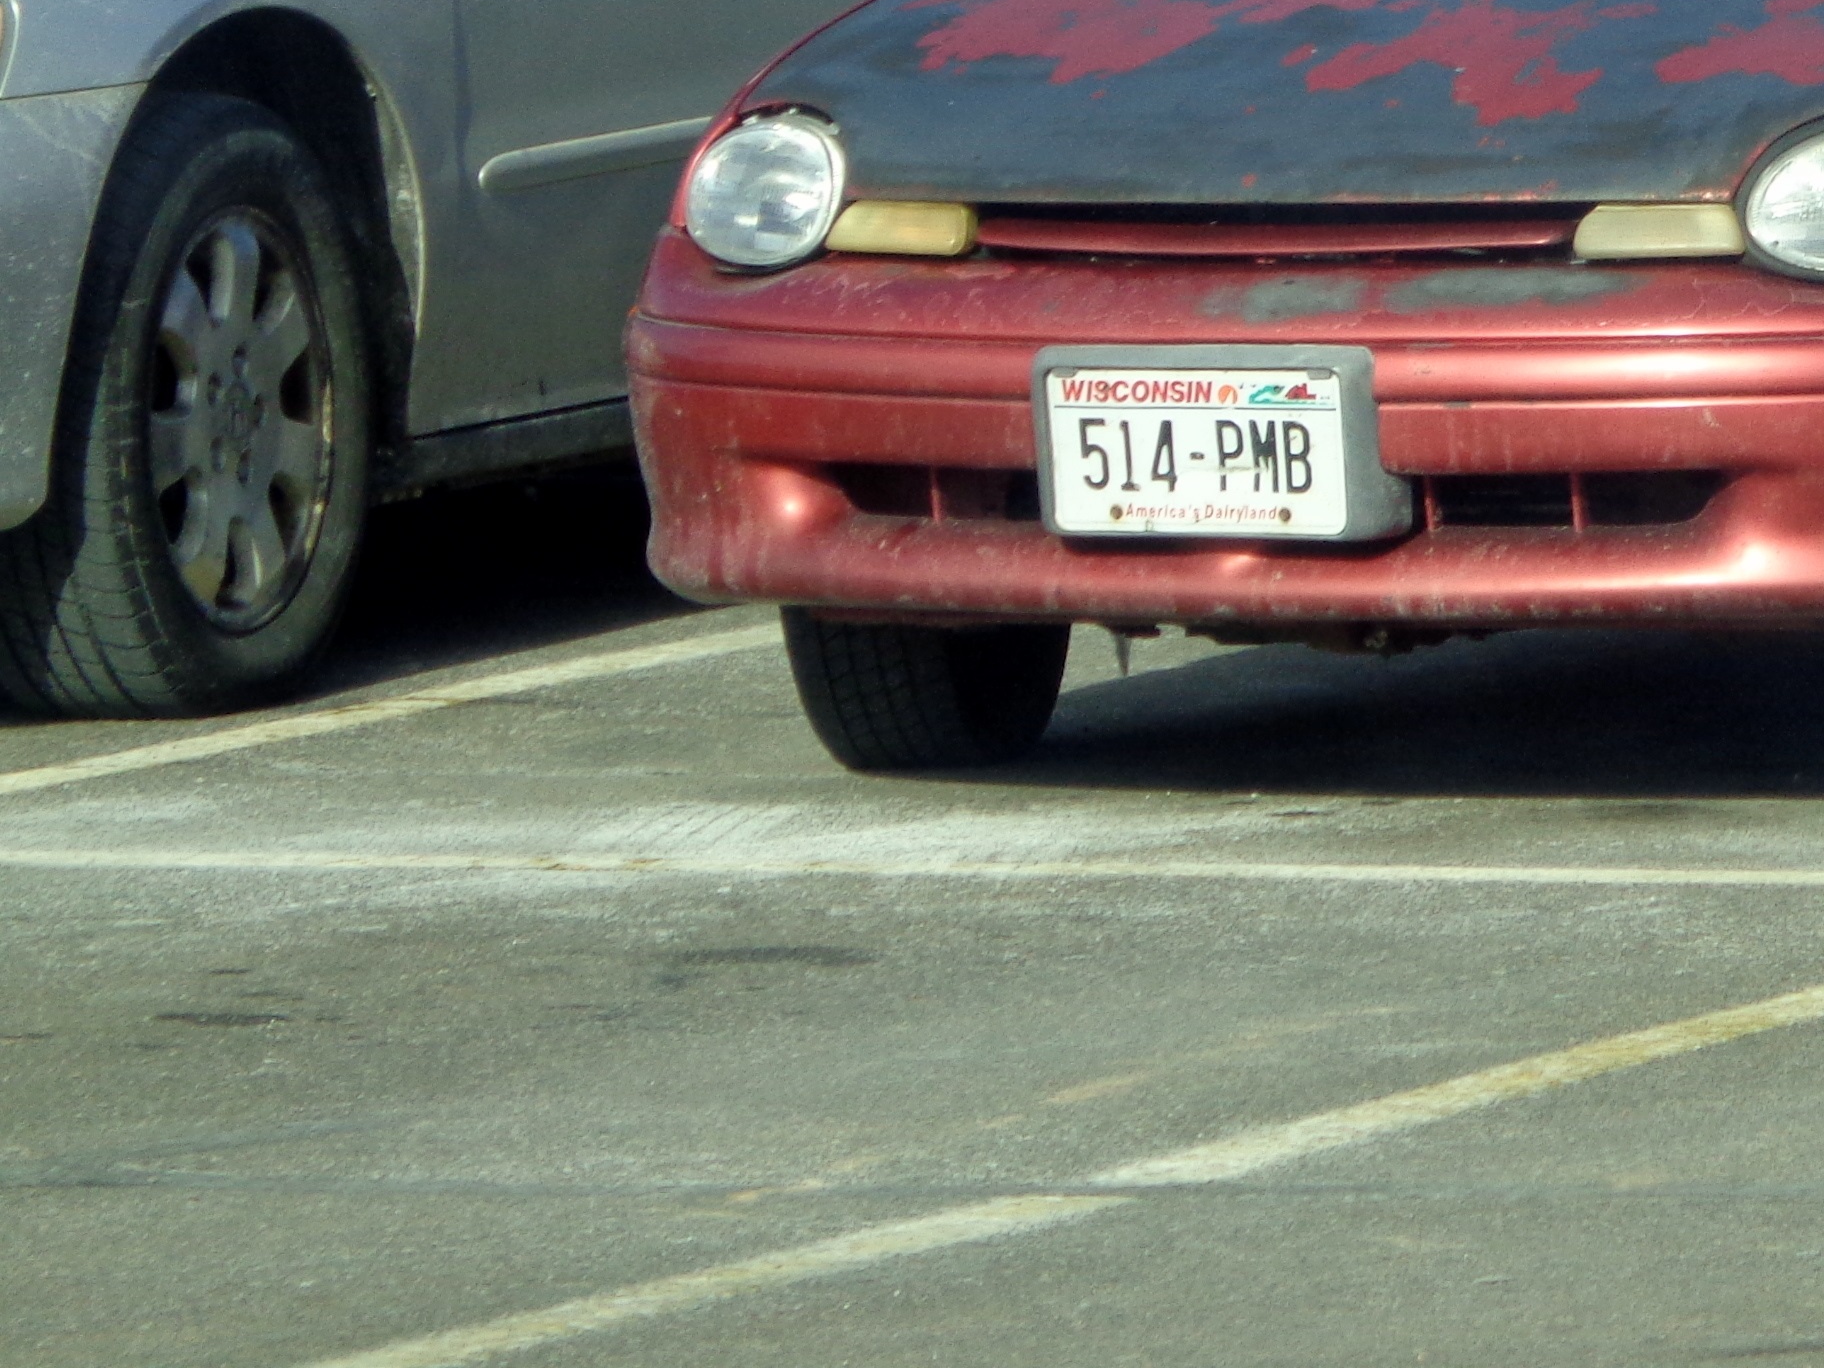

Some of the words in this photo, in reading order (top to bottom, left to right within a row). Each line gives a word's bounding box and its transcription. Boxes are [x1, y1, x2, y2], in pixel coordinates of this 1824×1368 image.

[1062, 379, 1212, 404] WISCONSIN
[1079, 418, 1313, 494] 514-PMB
[1125, 503, 1199, 520] America's
[1204, 504, 1277, 523] Dairyland
